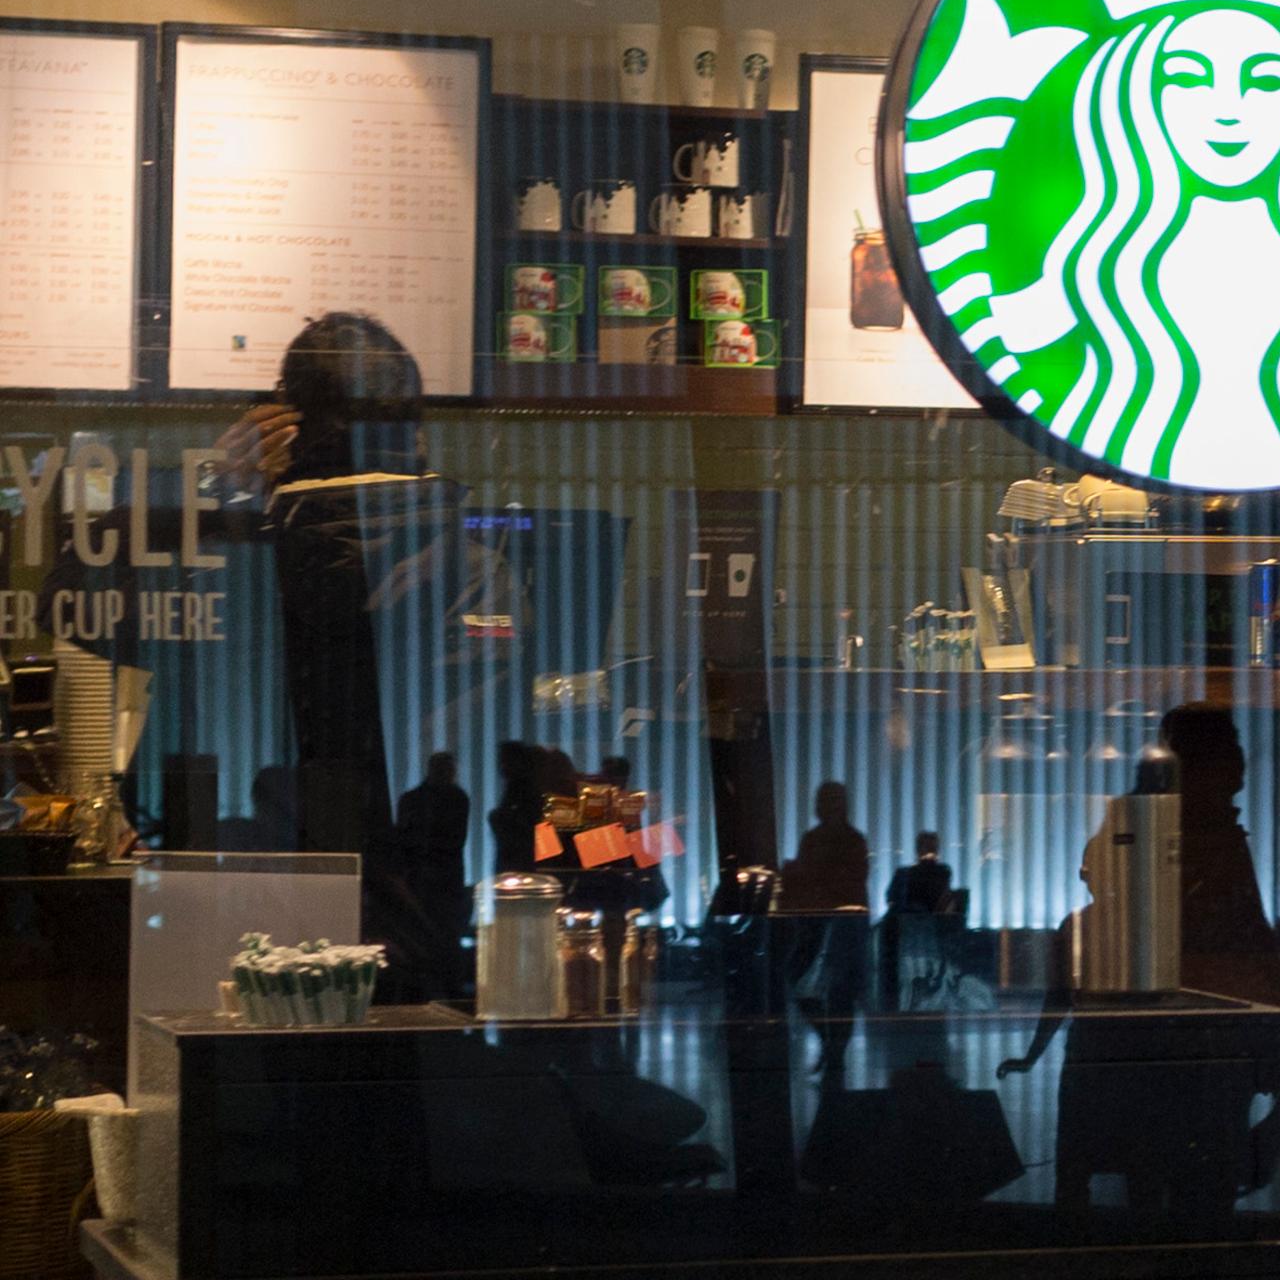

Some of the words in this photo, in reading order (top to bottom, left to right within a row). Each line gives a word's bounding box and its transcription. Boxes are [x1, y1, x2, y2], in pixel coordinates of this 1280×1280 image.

[0, 443, 228, 568] YCLE
[52, 588, 125, 641] CUP
[139, 590, 227, 641] HERE
